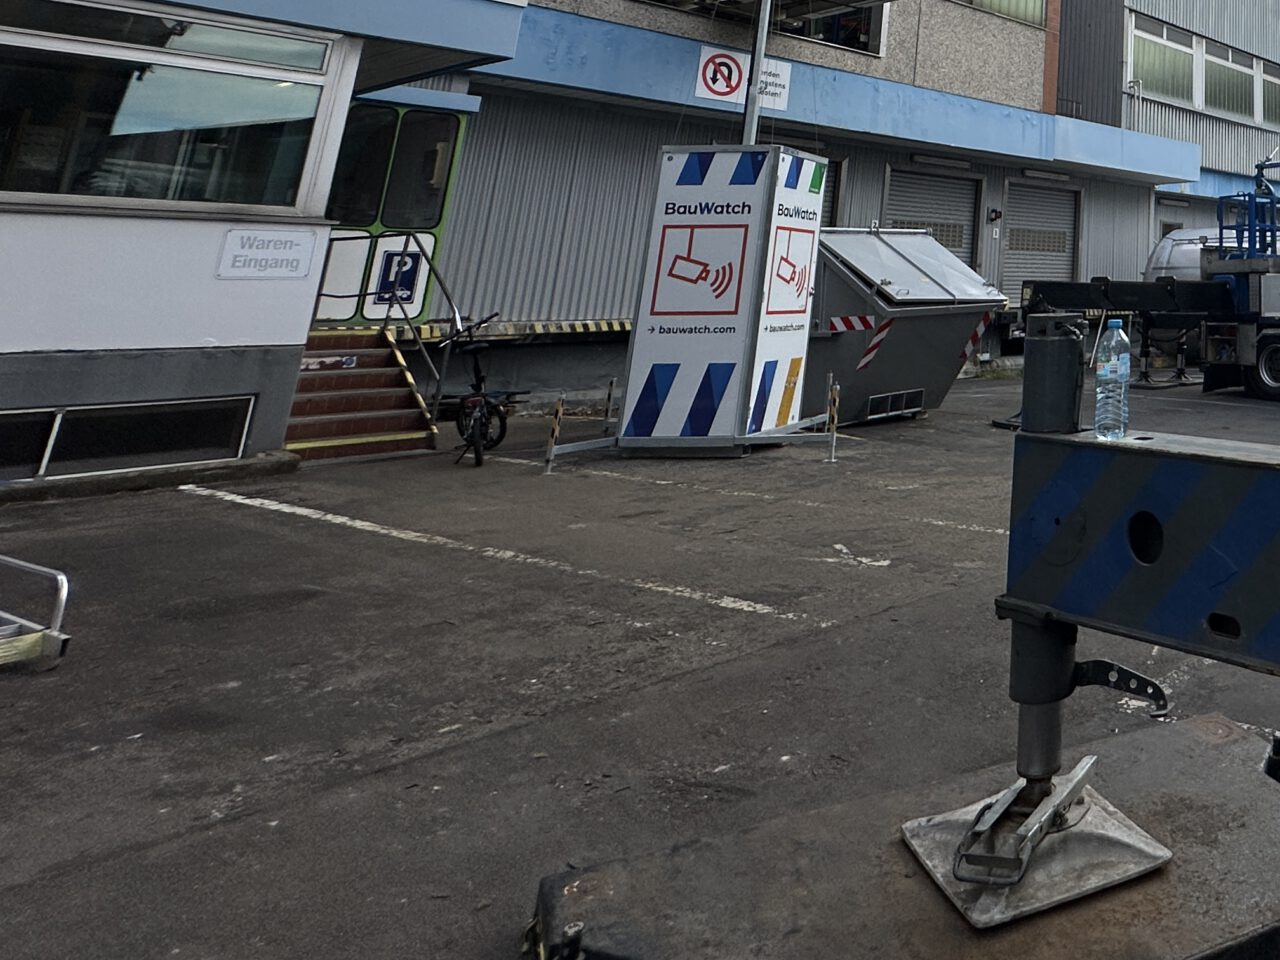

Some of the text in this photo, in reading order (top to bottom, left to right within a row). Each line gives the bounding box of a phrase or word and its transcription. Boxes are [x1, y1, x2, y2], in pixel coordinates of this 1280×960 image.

[664, 202, 752, 216] BauWatch
[777, 203, 818, 222] BauWatch
[240, 235, 301, 251] Waren-
[231, 254, 301, 272] Eingang
[389, 256, 413, 281] P
[658, 324, 736, 335] bauwatch.com
